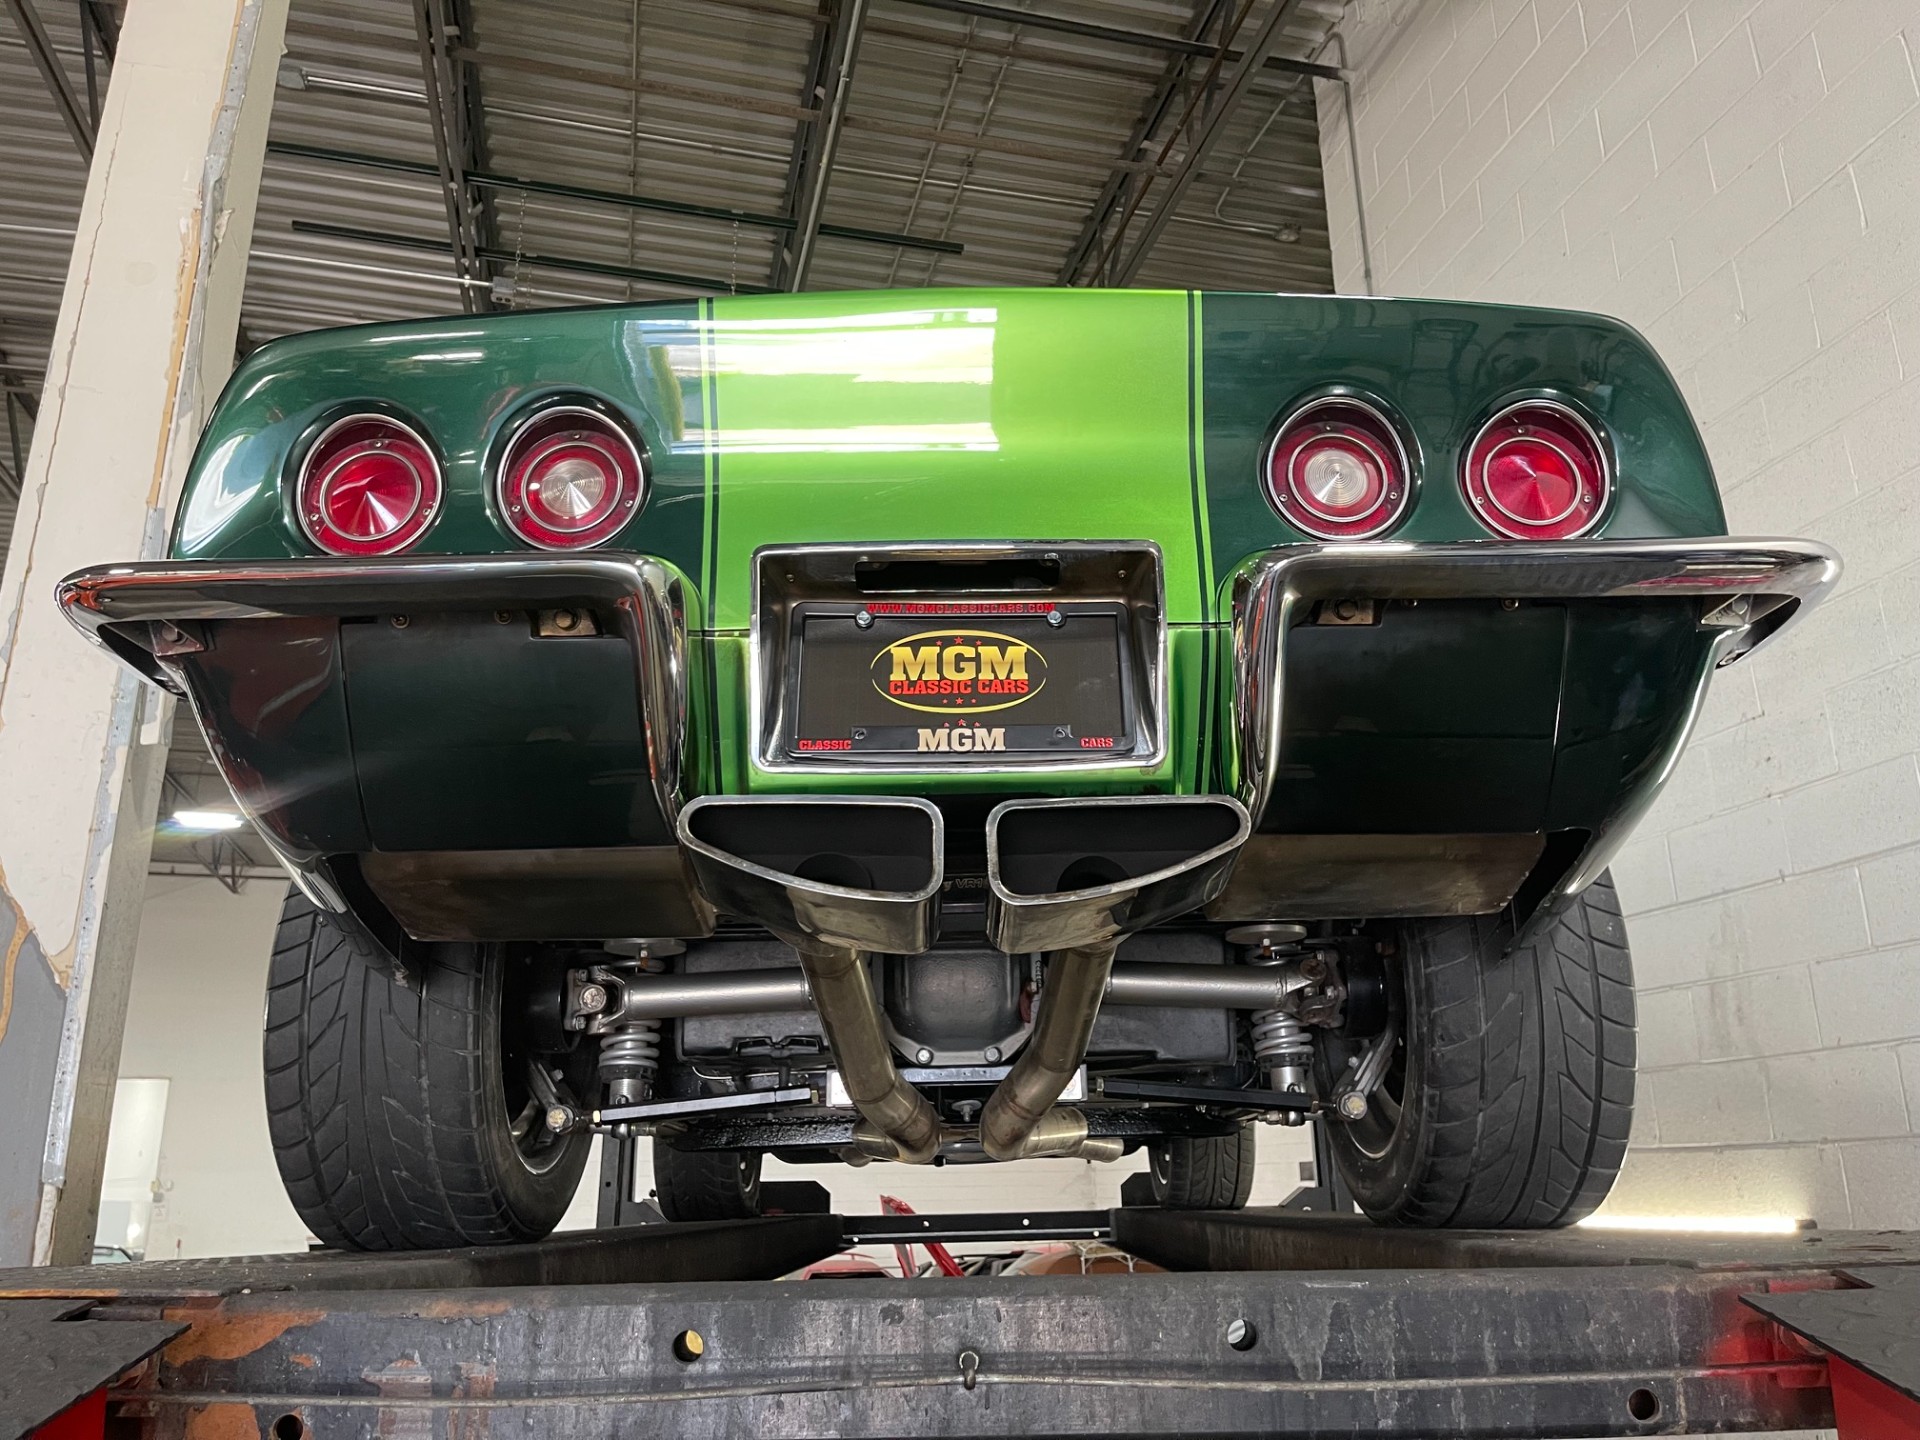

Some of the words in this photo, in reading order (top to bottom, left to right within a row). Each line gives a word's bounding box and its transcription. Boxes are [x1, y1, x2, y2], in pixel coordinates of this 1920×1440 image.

[867, 602, 1055, 614] WWW.MGMCLASSICCARS.COM
[890, 645, 1029, 680] MGM
[889, 679, 972, 695] CLASSIC
[977, 679, 1029, 694] CARS
[799, 739, 852, 750] CLASSIC
[917, 728, 1006, 752] MGM
[1081, 737, 1113, 748] CARS
